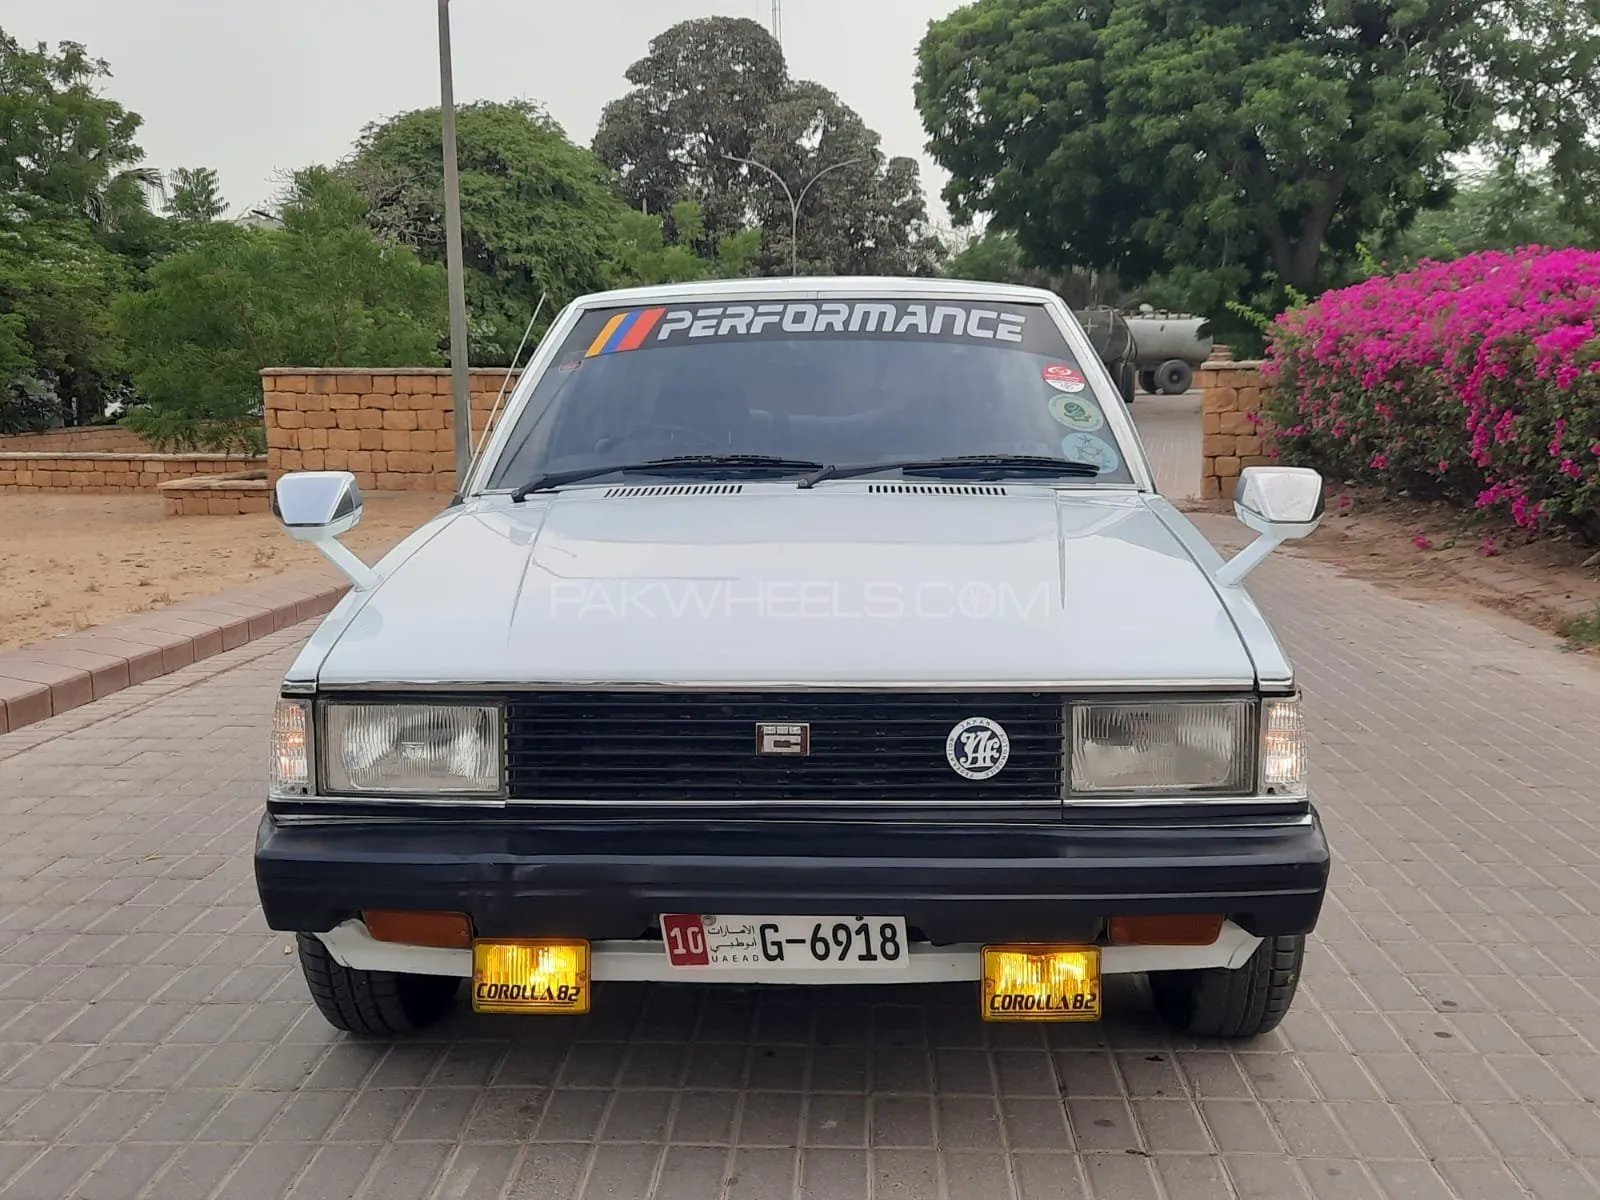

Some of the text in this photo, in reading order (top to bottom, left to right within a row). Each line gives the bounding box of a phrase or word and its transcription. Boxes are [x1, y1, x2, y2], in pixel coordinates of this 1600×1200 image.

[656, 303, 1025, 343] PERFORMANCE
[960, 719, 991, 730] JAPAN
[669, 926, 704, 954] 10
[760, 922, 900, 962] G-6918
[477, 983, 580, 1002] COROLLA 82
[990, 993, 1097, 1011] COROLLA 82
